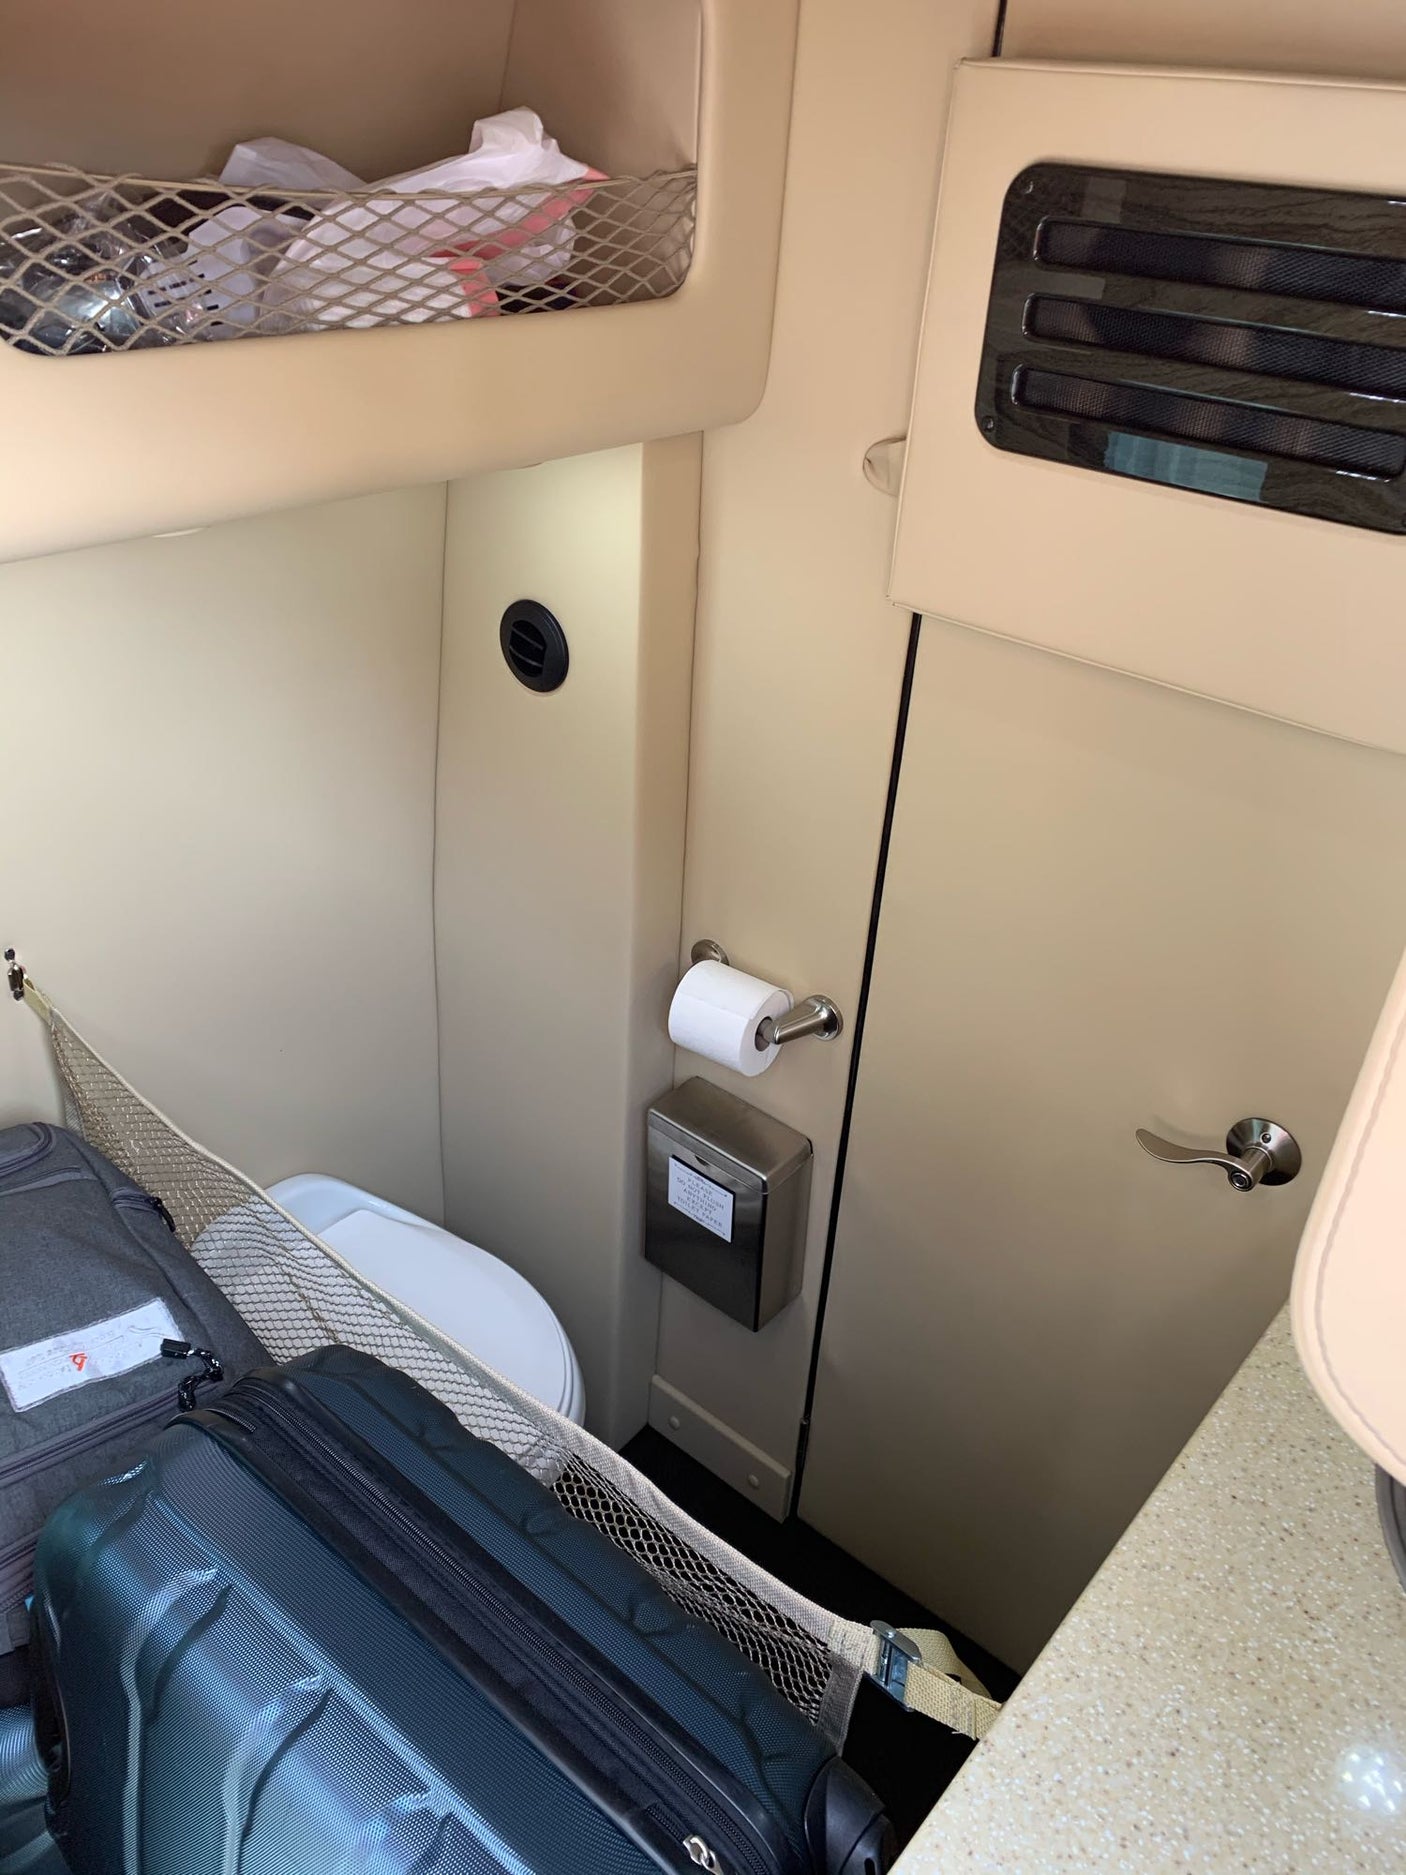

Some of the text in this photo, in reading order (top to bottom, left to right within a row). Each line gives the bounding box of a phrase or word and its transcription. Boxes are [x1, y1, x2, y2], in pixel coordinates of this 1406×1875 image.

[683, 1188, 716, 1211] ANYTHING
[688, 1184, 700, 1194] NOT
[677, 1196, 722, 1227] TOILET PAPER
